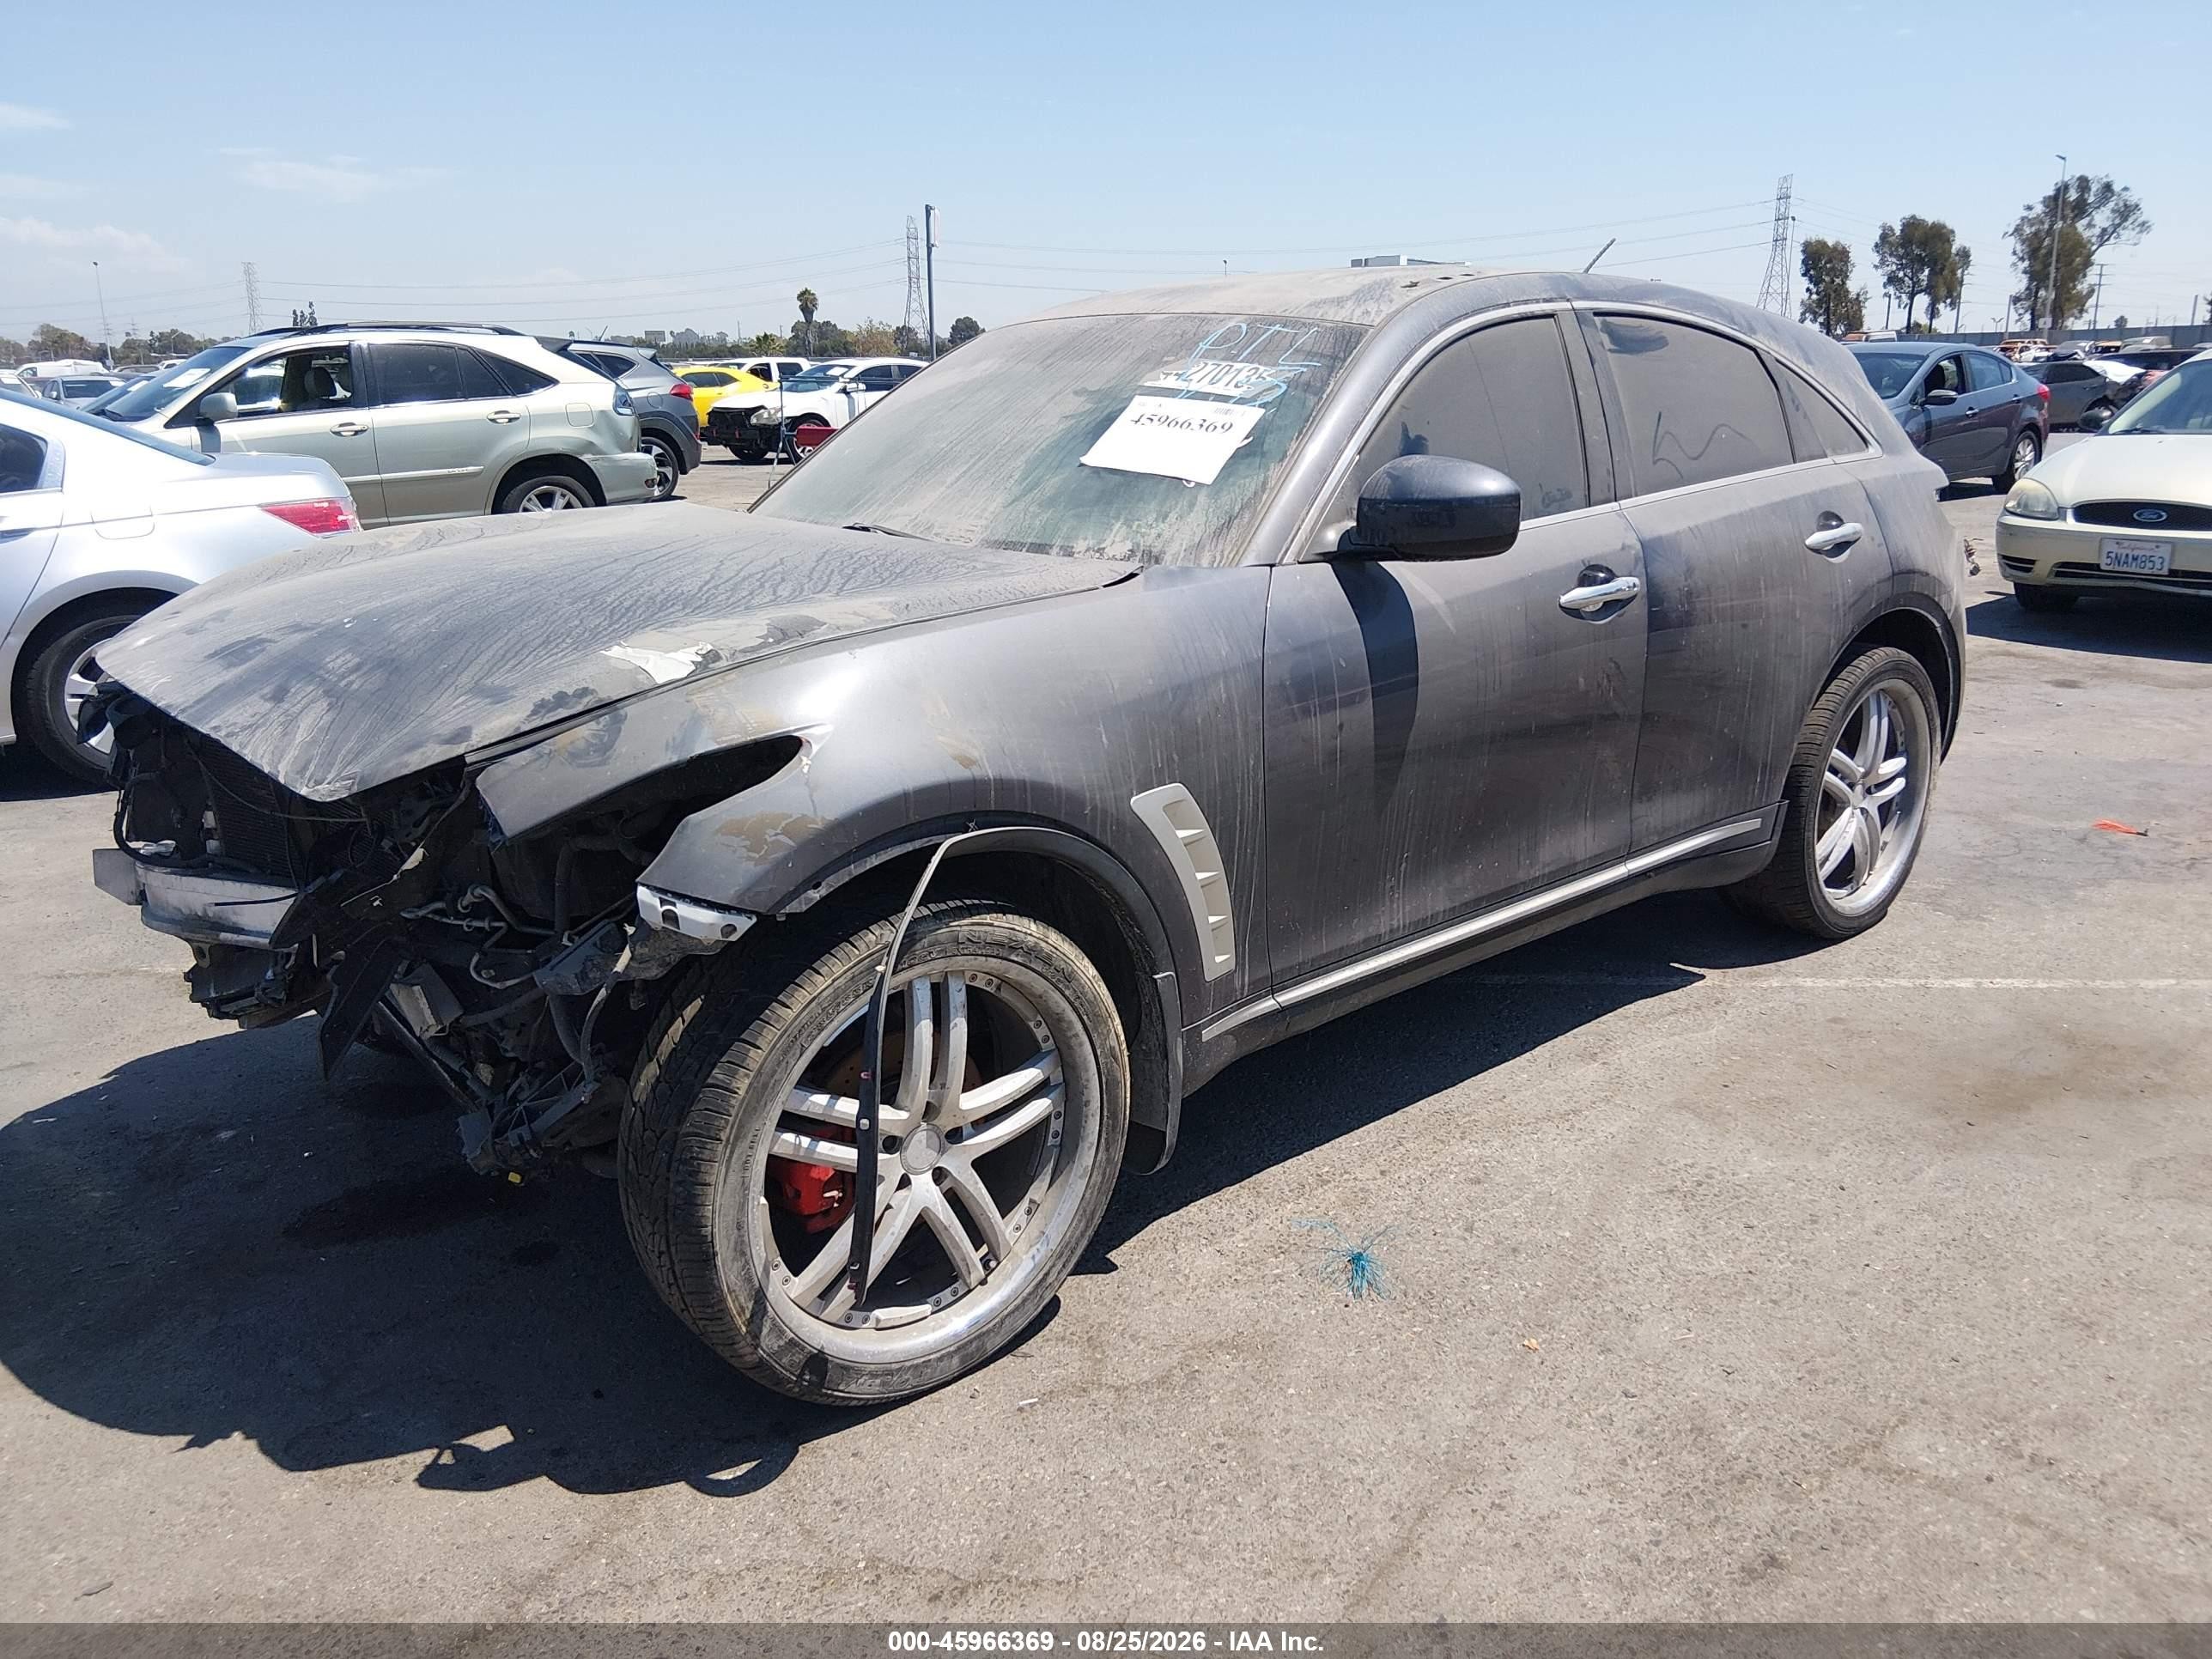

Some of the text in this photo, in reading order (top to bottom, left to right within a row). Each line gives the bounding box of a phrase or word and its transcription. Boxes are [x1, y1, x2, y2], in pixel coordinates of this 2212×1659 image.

[1129, 413, 1234, 434] 45966369
[2105, 550, 2165, 571] 5NAM853
[958, 927, 1074, 984] NEXEN
